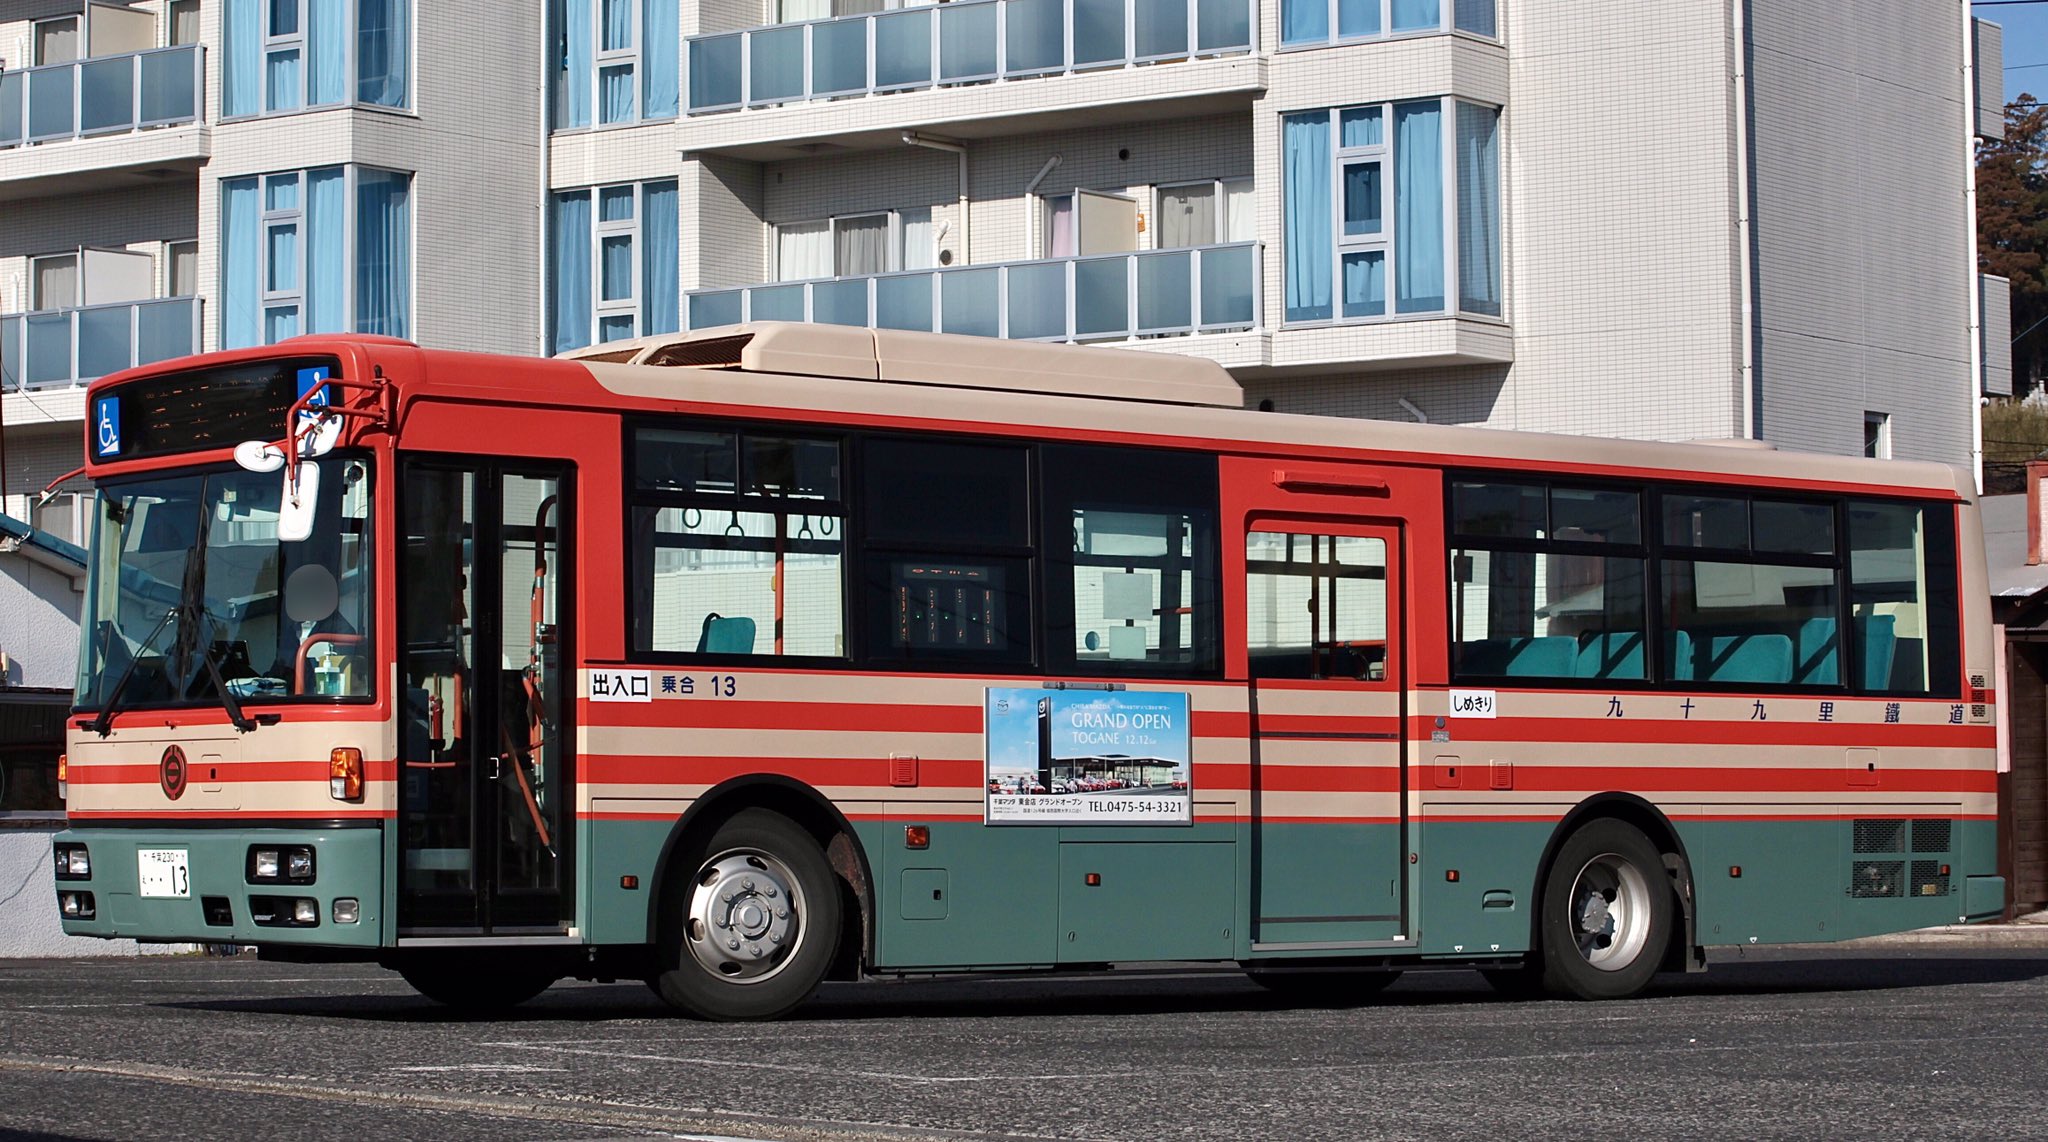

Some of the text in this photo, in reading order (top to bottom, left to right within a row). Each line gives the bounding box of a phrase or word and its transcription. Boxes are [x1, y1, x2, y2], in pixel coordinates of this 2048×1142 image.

[593, 674, 648, 697] 出入口
[662, 675, 736, 697] 乗合 13
[1453, 695, 1493, 713] しめきり
[1071, 712, 1171, 729] GRAND OPEN
[1072, 731, 1120, 745] TOGANE
[1039, 798, 1083, 806] グランドオープン
[1088, 801, 1182, 813] TEL.0475-54-3321
